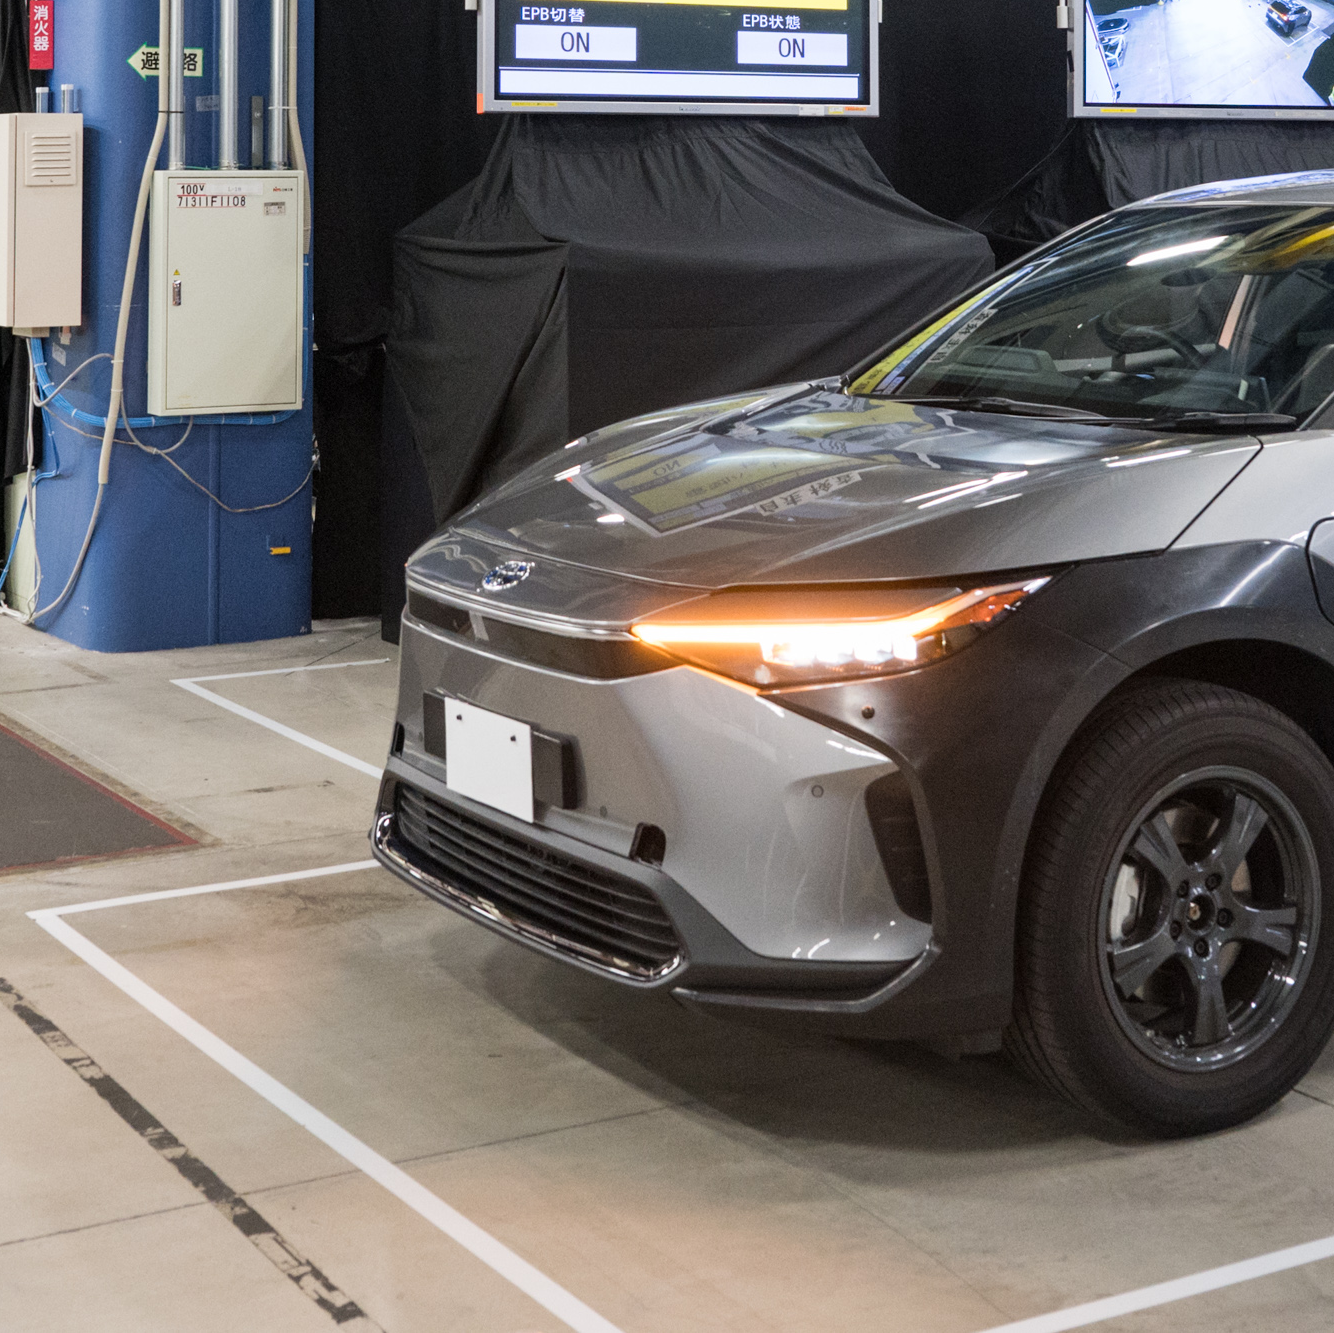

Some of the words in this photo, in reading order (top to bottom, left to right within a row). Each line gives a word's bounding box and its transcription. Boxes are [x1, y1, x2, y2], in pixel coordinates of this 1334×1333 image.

[521, 6, 585, 23] EPB切替
[742, 13, 801, 30] EPB状態
[33, 5, 50, 51] 消火器
[560, 31, 591, 53] ON
[777, 37, 806, 59] ON
[140, 51, 198, 72] 避路
[177, 196, 246, 207] 71311F1108
